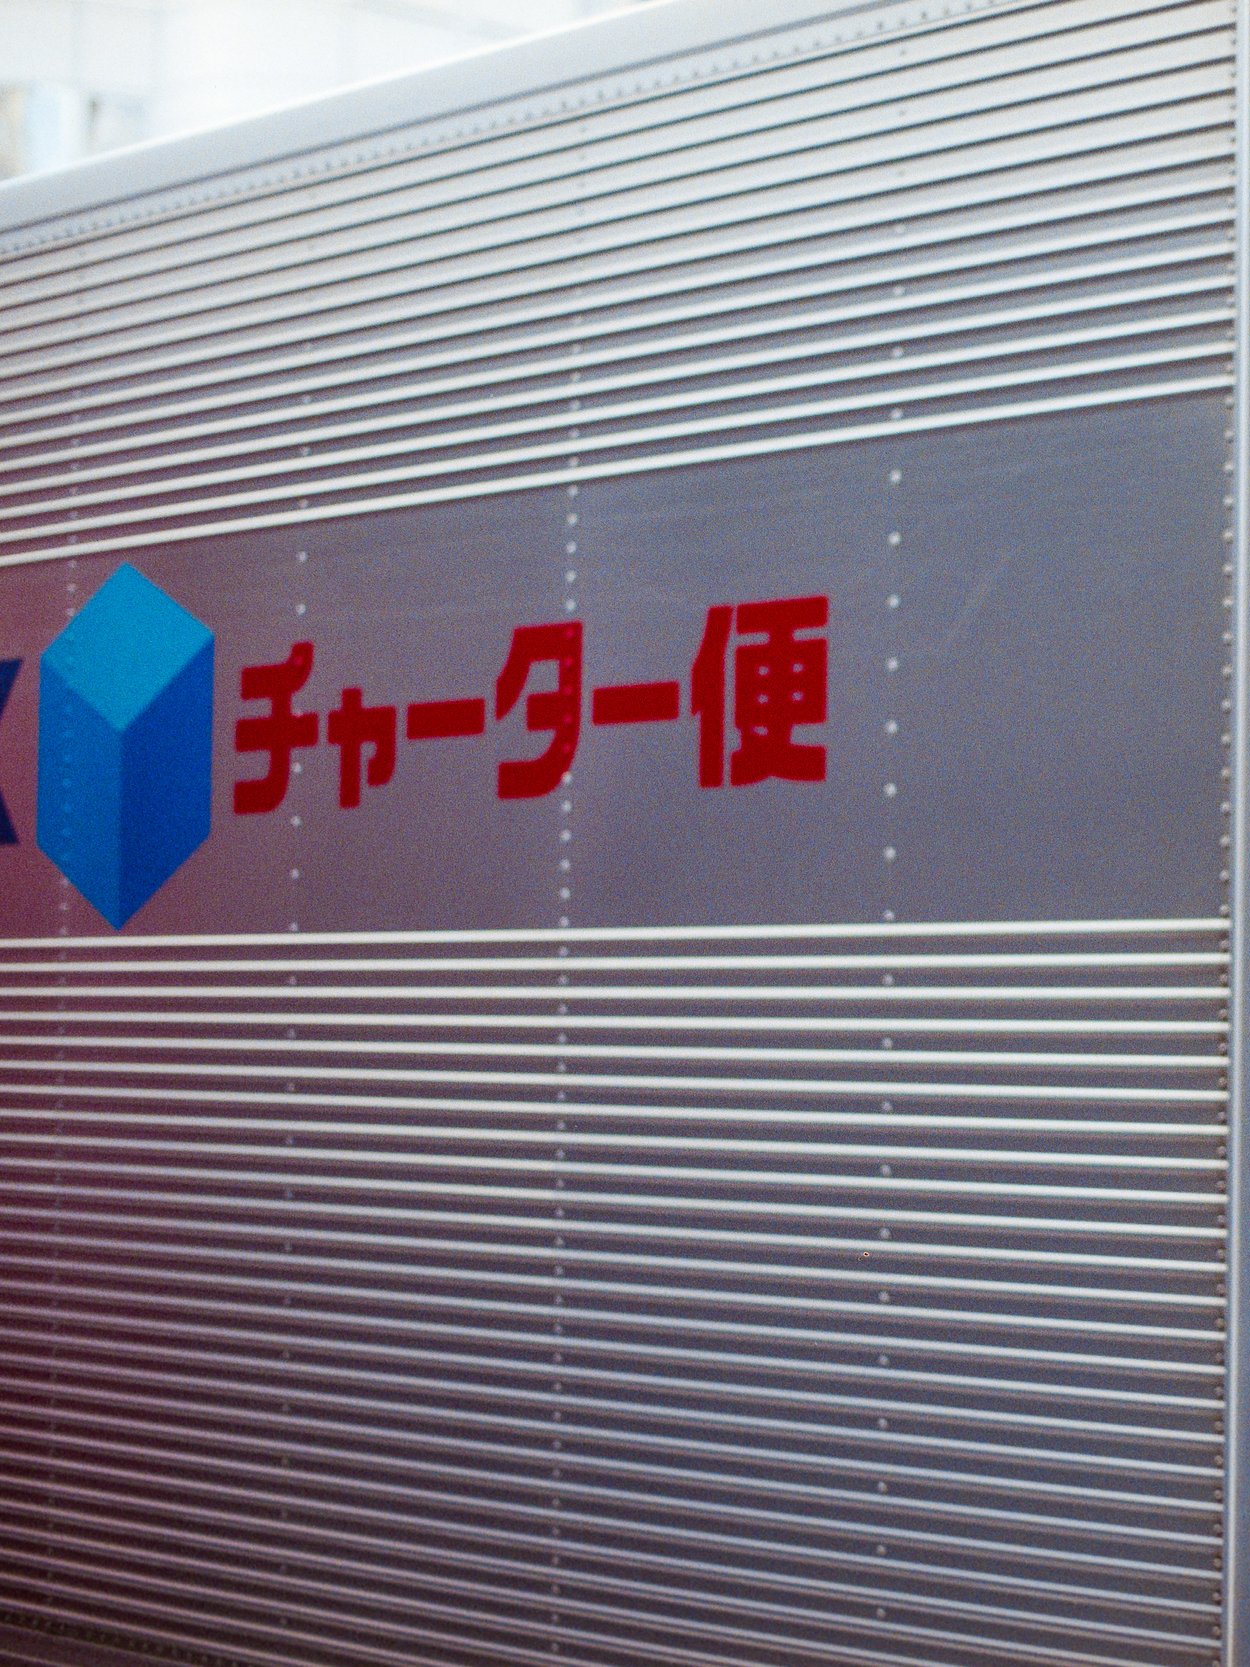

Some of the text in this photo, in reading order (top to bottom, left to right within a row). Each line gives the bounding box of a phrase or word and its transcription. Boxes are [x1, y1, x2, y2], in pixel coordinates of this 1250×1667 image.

[234, 595, 829, 815] チャーター便
